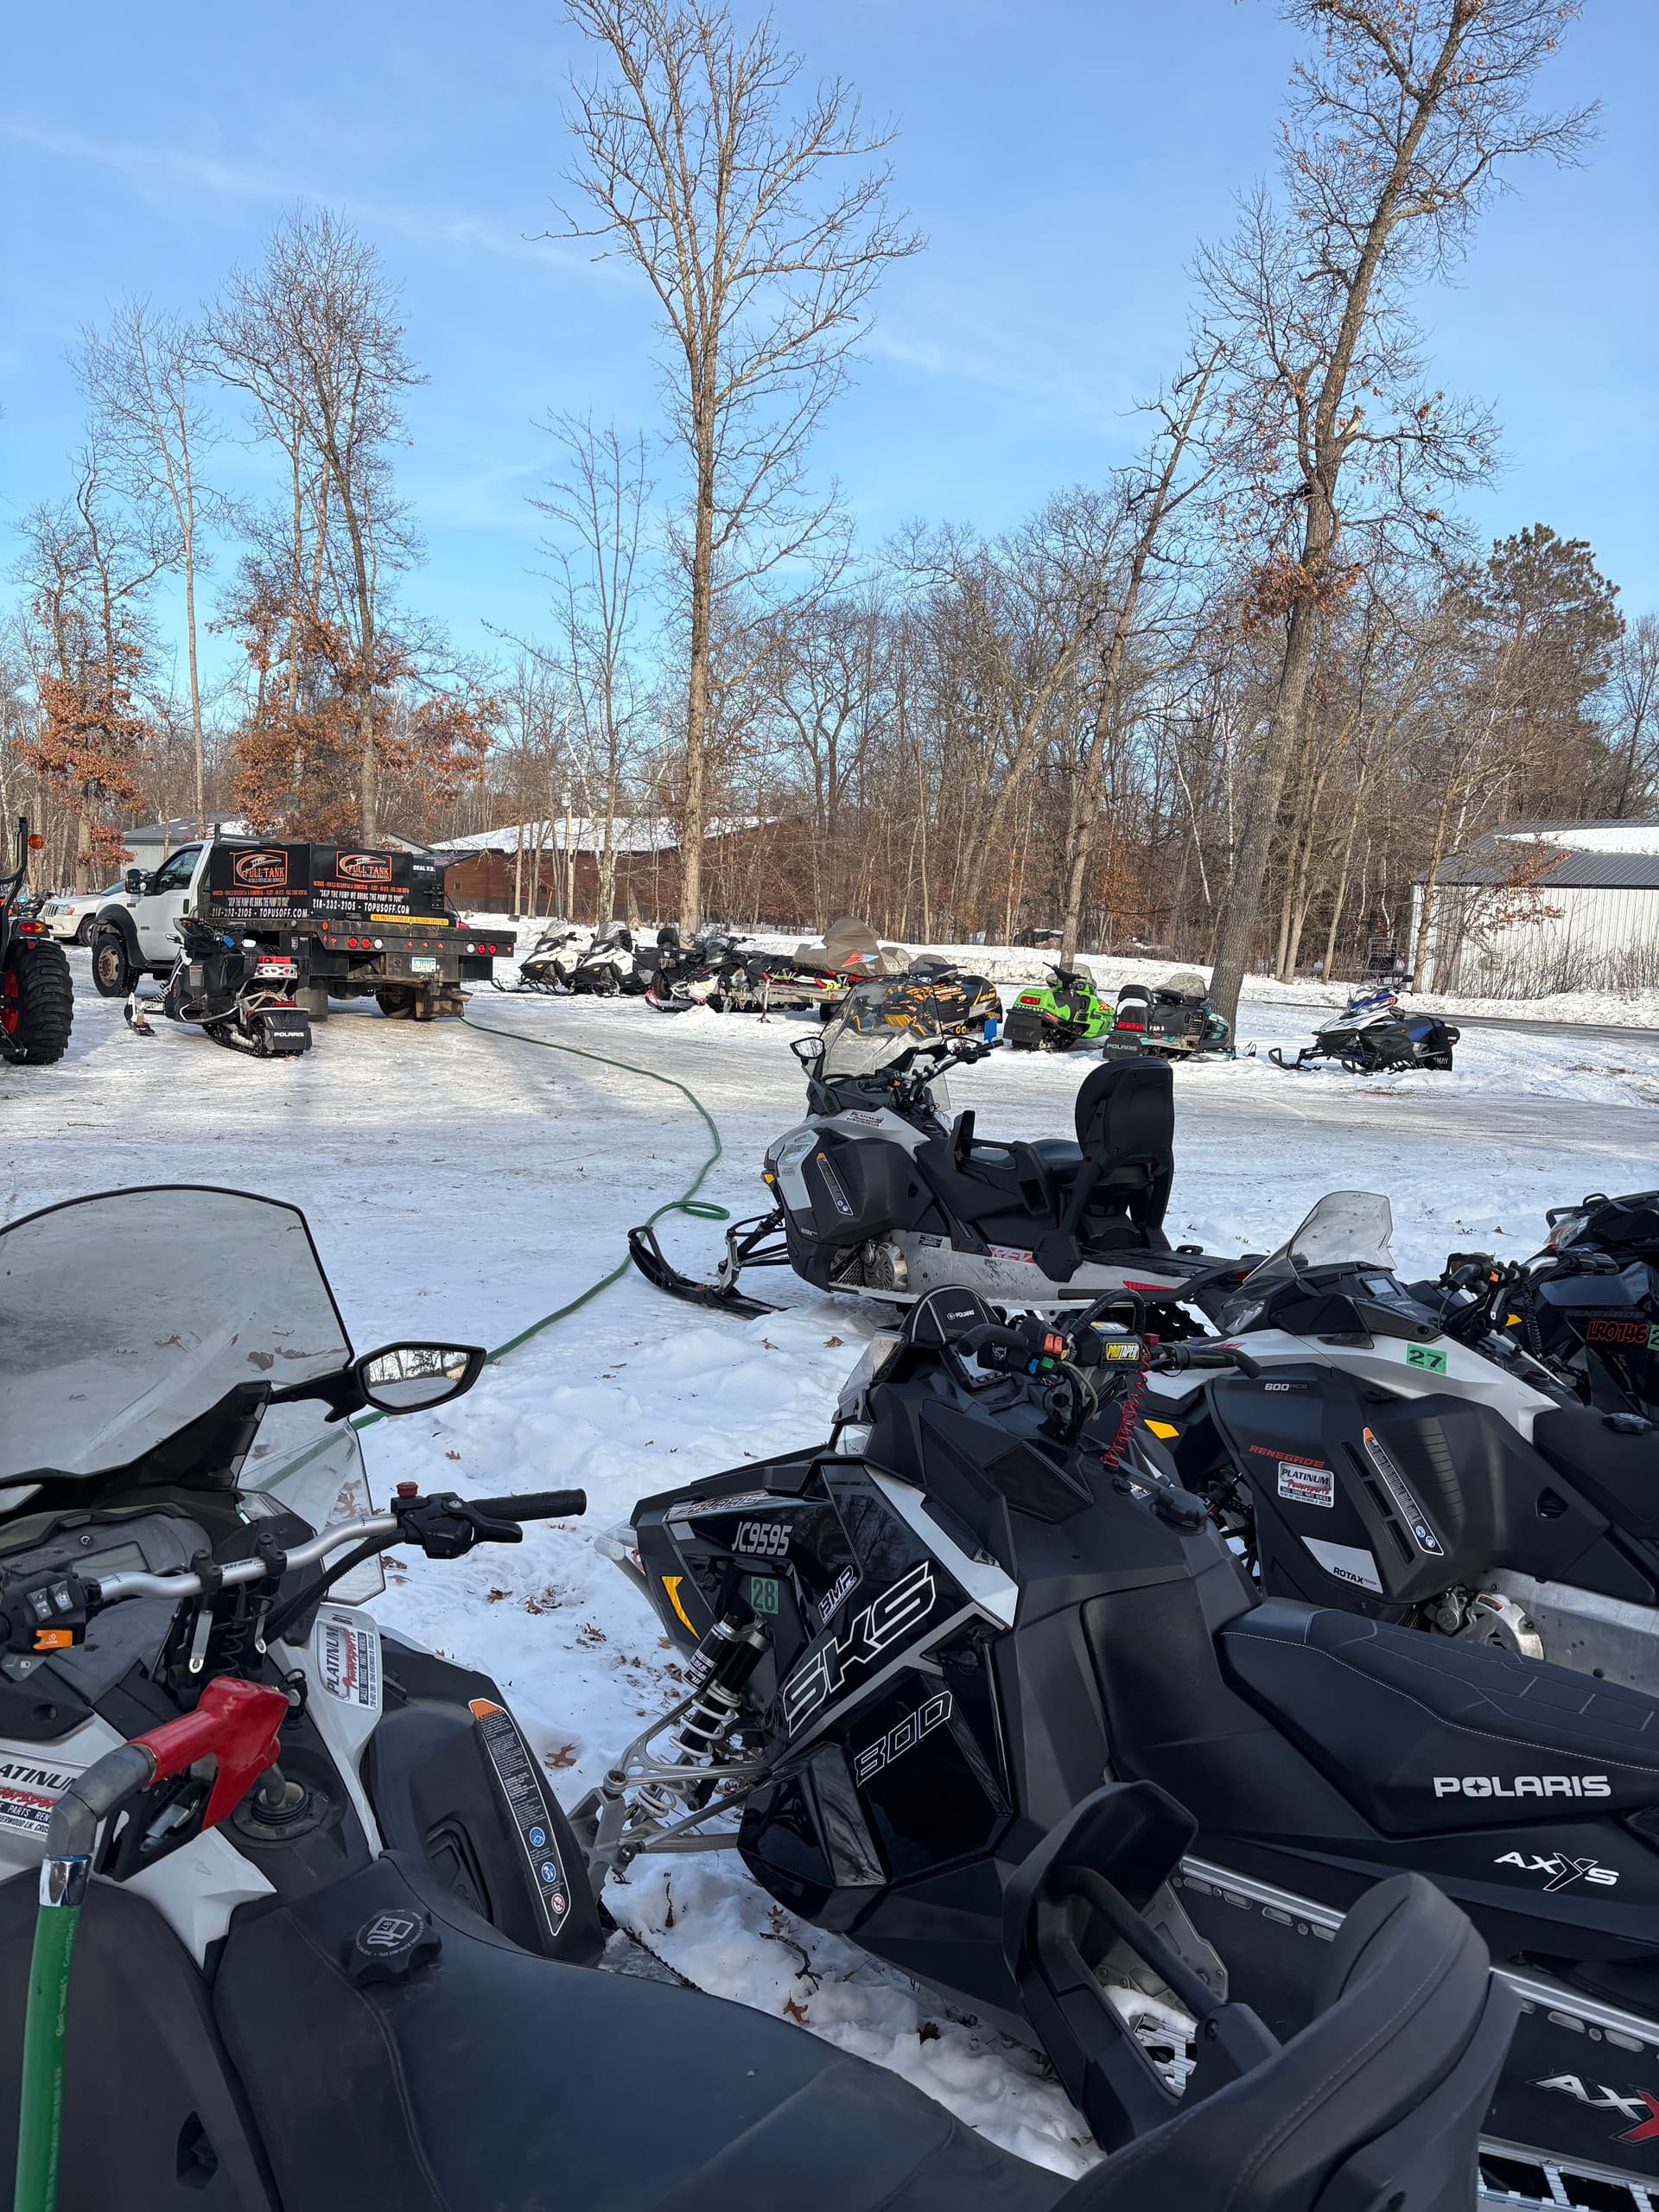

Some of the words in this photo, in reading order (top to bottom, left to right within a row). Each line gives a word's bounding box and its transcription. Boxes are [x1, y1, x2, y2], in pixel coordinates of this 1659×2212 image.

[245, 868, 263, 877] FULL
[264, 867, 285, 877] TANK
[348, 864, 367, 874] FULL
[368, 866, 389, 875] TANK
[259, 908, 308, 918] TOPUSOFF.COM
[312, 899, 356, 911] 218-232-2105
[364, 902, 410, 914] TOPUSOFF.COM
[1107, 1043, 1139, 1052] POLARIS
[1408, 1348, 1444, 1370] 27
[1249, 1445, 1325, 1469] RENEGADE
[1281, 1469, 1330, 1485] PLATINUM
[675, 1495, 761, 1516] POLARIS
[732, 1521, 794, 1556] JC9595
[1333, 1567, 1363, 1585] ROTAX
[753, 1579, 776, 1611] 28
[782, 1560, 937, 1738] SKS
[327, 1625, 340, 1695] PLATINUM
[359, 1688, 368, 1701] SALES
[855, 1690, 953, 1789] 800
[1433, 1775, 1611, 1798] POLARIS
[7, 1805, 31, 1817] PARTS
[1493, 1851, 1620, 1893] AXYS
